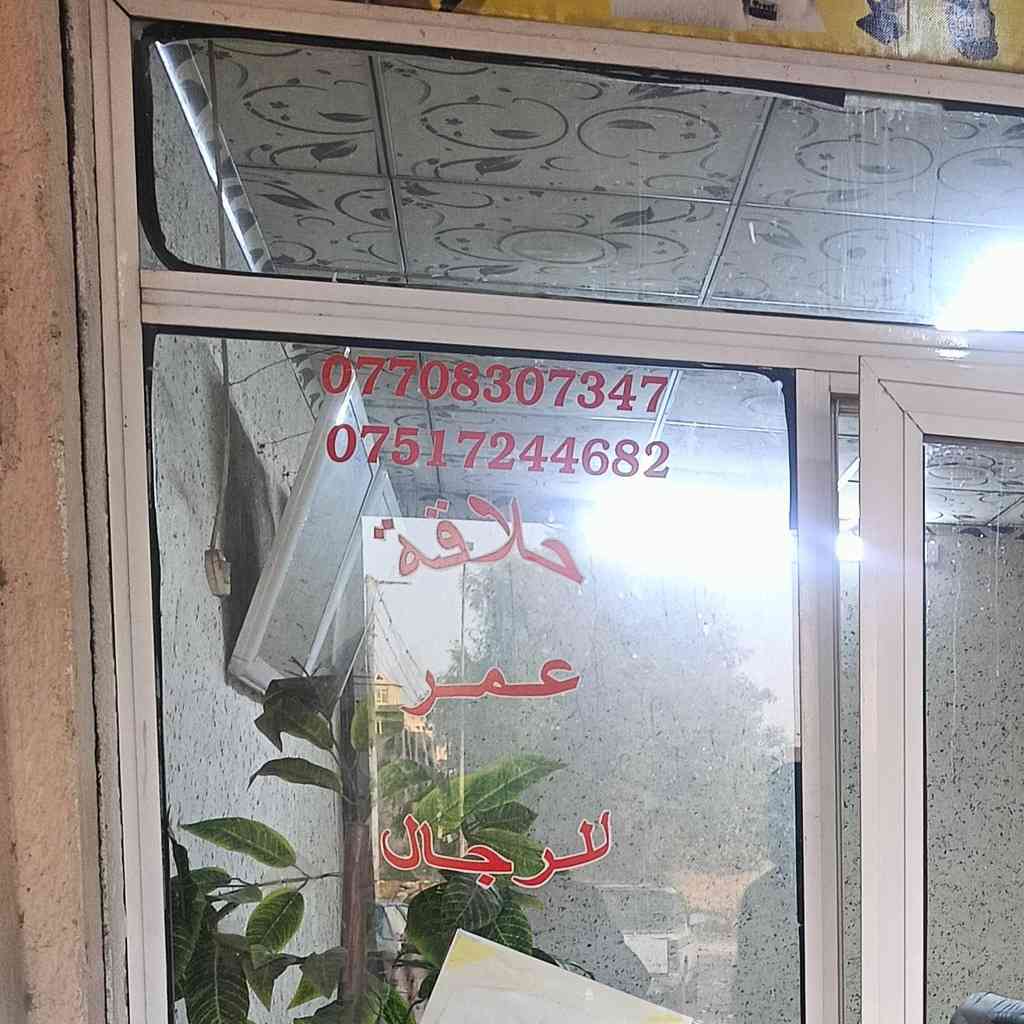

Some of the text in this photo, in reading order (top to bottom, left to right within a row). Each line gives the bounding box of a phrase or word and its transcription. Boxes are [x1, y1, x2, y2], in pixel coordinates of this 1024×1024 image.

[320, 353, 670, 413] 07708307347
[326, 422, 671, 479] 07517244682
[373, 494, 585, 586] حلاقة
[402, 656, 580, 717] عمر
[380, 811, 613, 890] للرجال
